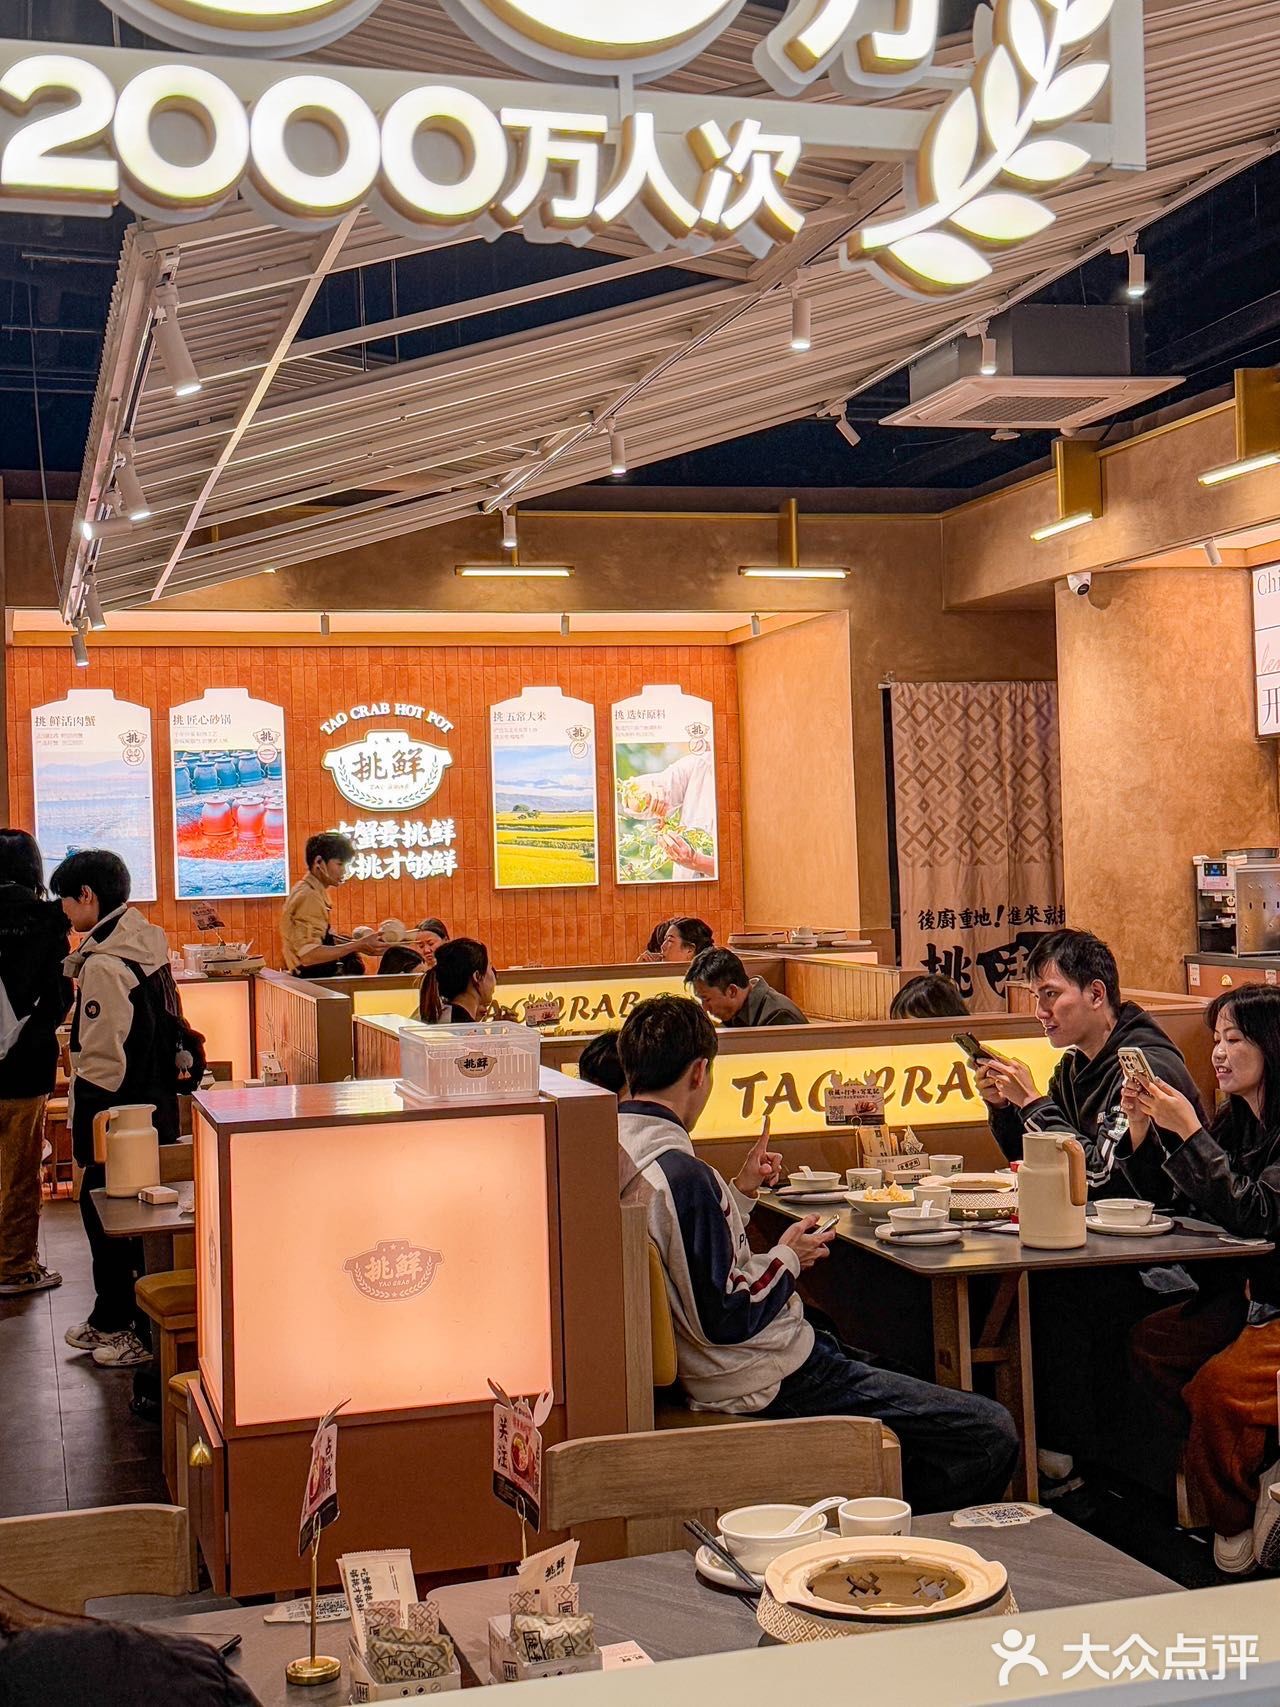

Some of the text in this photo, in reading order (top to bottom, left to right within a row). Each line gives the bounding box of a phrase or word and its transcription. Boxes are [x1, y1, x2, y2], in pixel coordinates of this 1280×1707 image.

[0, 54, 804, 238] 2000万人次
[173, 714, 184, 726] 挑
[320, 702, 455, 735] TAO CRAB HOT POT
[493, 711, 546, 722] 挑 五常大米
[615, 709, 666, 720] 挑 选好原料
[35, 715, 47, 727] 挑
